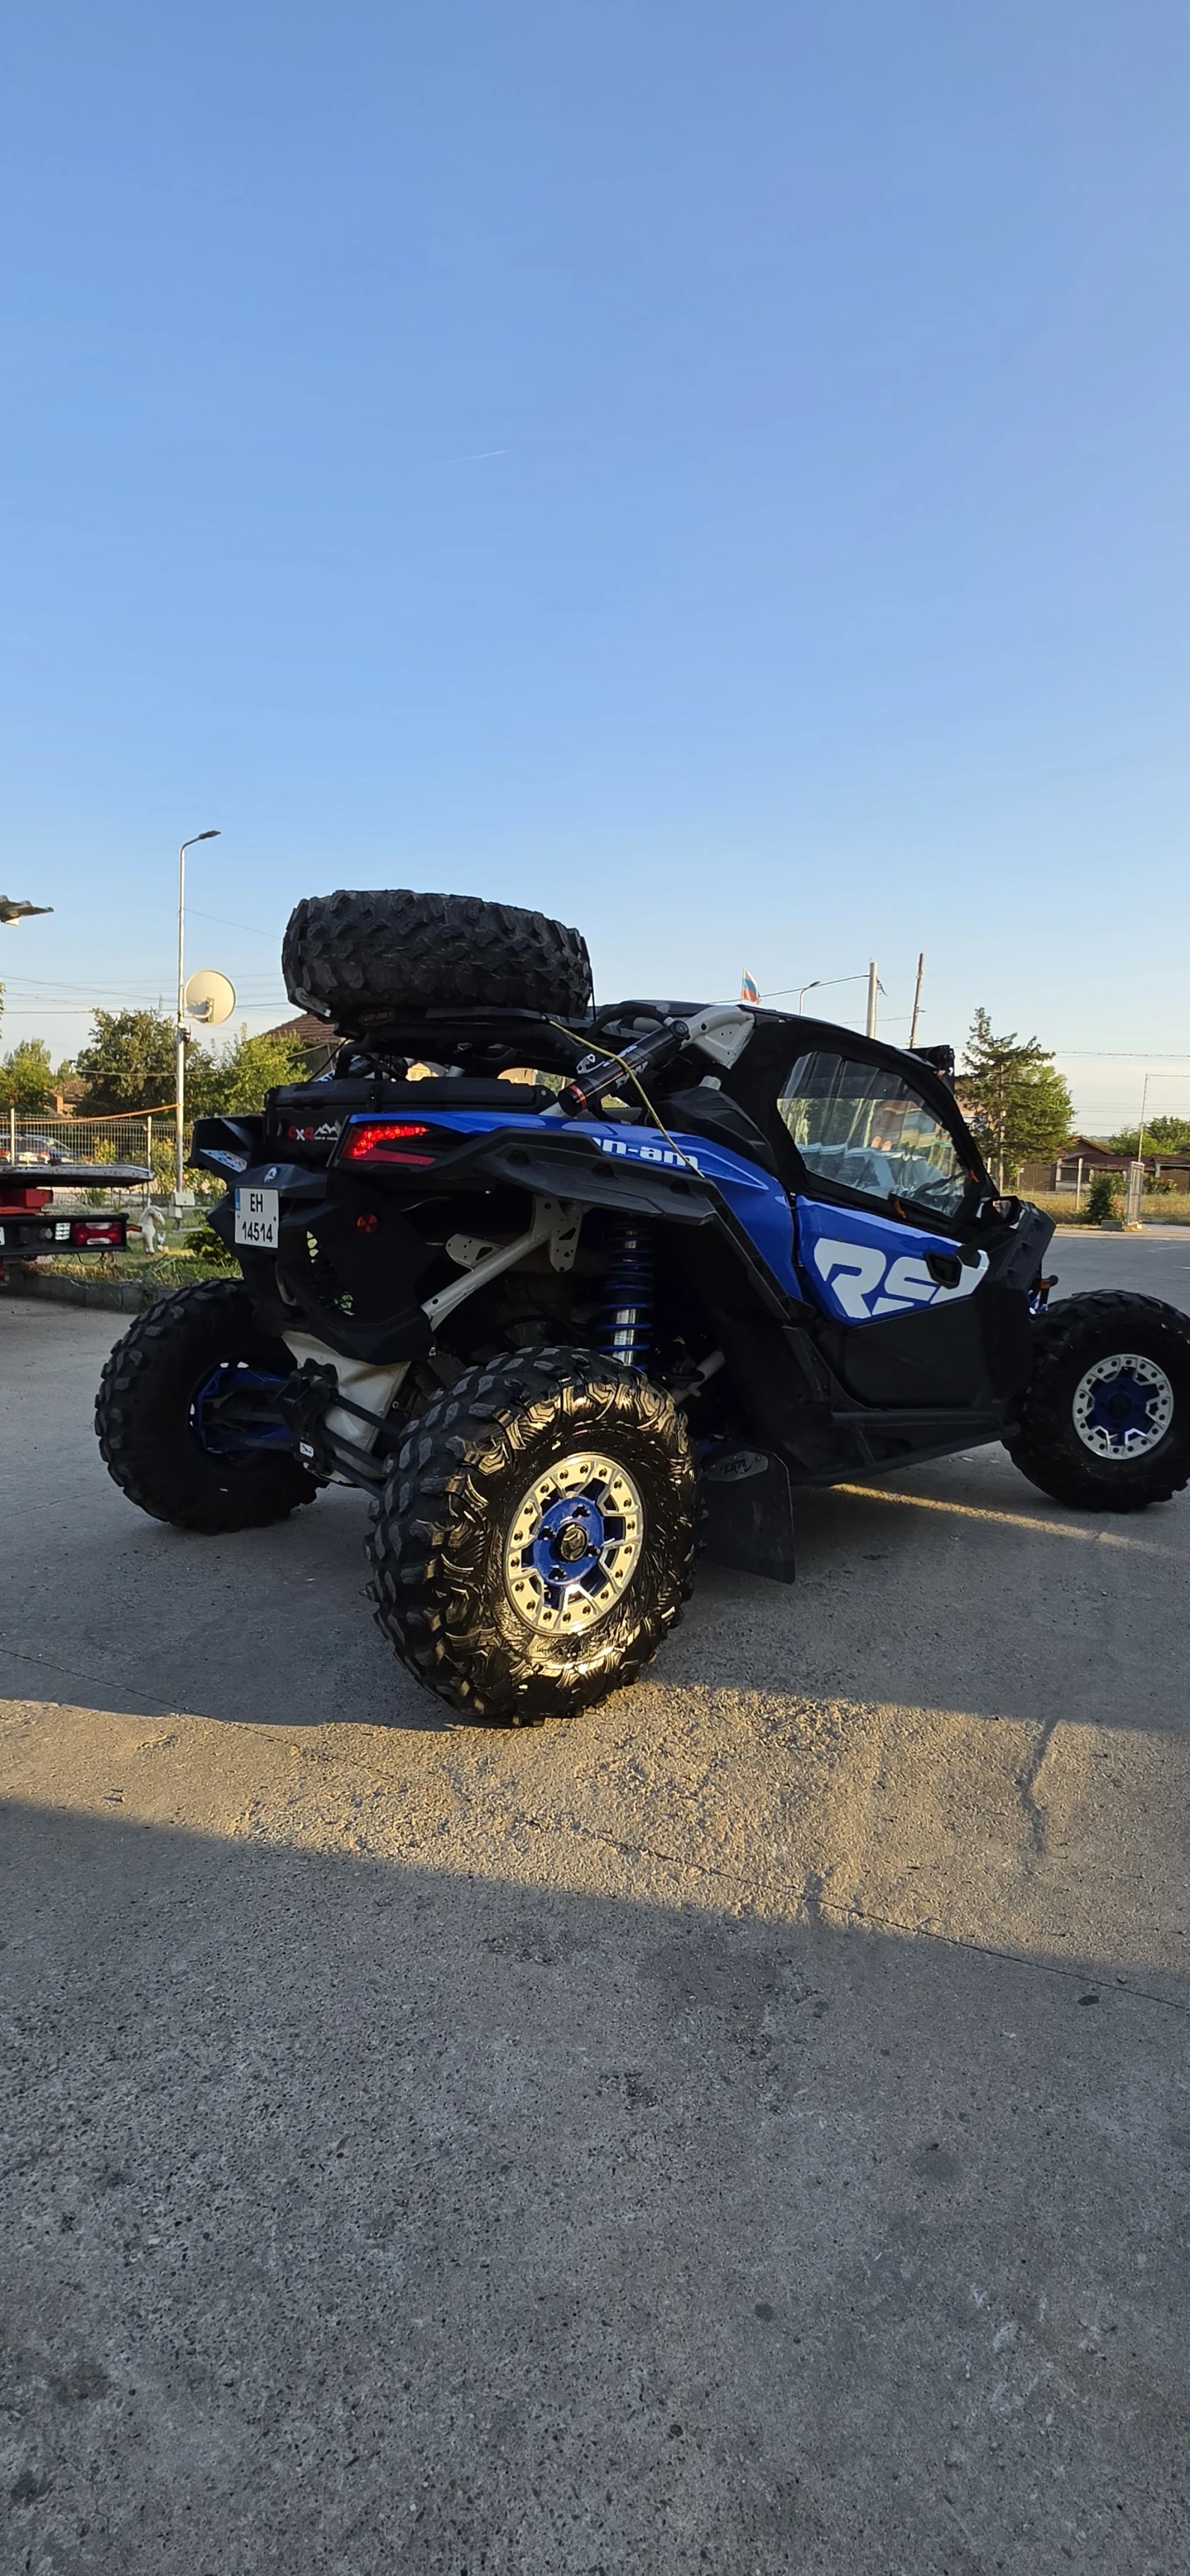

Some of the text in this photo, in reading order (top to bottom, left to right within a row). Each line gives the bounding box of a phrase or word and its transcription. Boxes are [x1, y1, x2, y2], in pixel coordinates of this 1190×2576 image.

[286, 1125, 314, 1141] 4x4
[250, 1193, 263, 1212] EH
[242, 1221, 273, 1243] 14514
